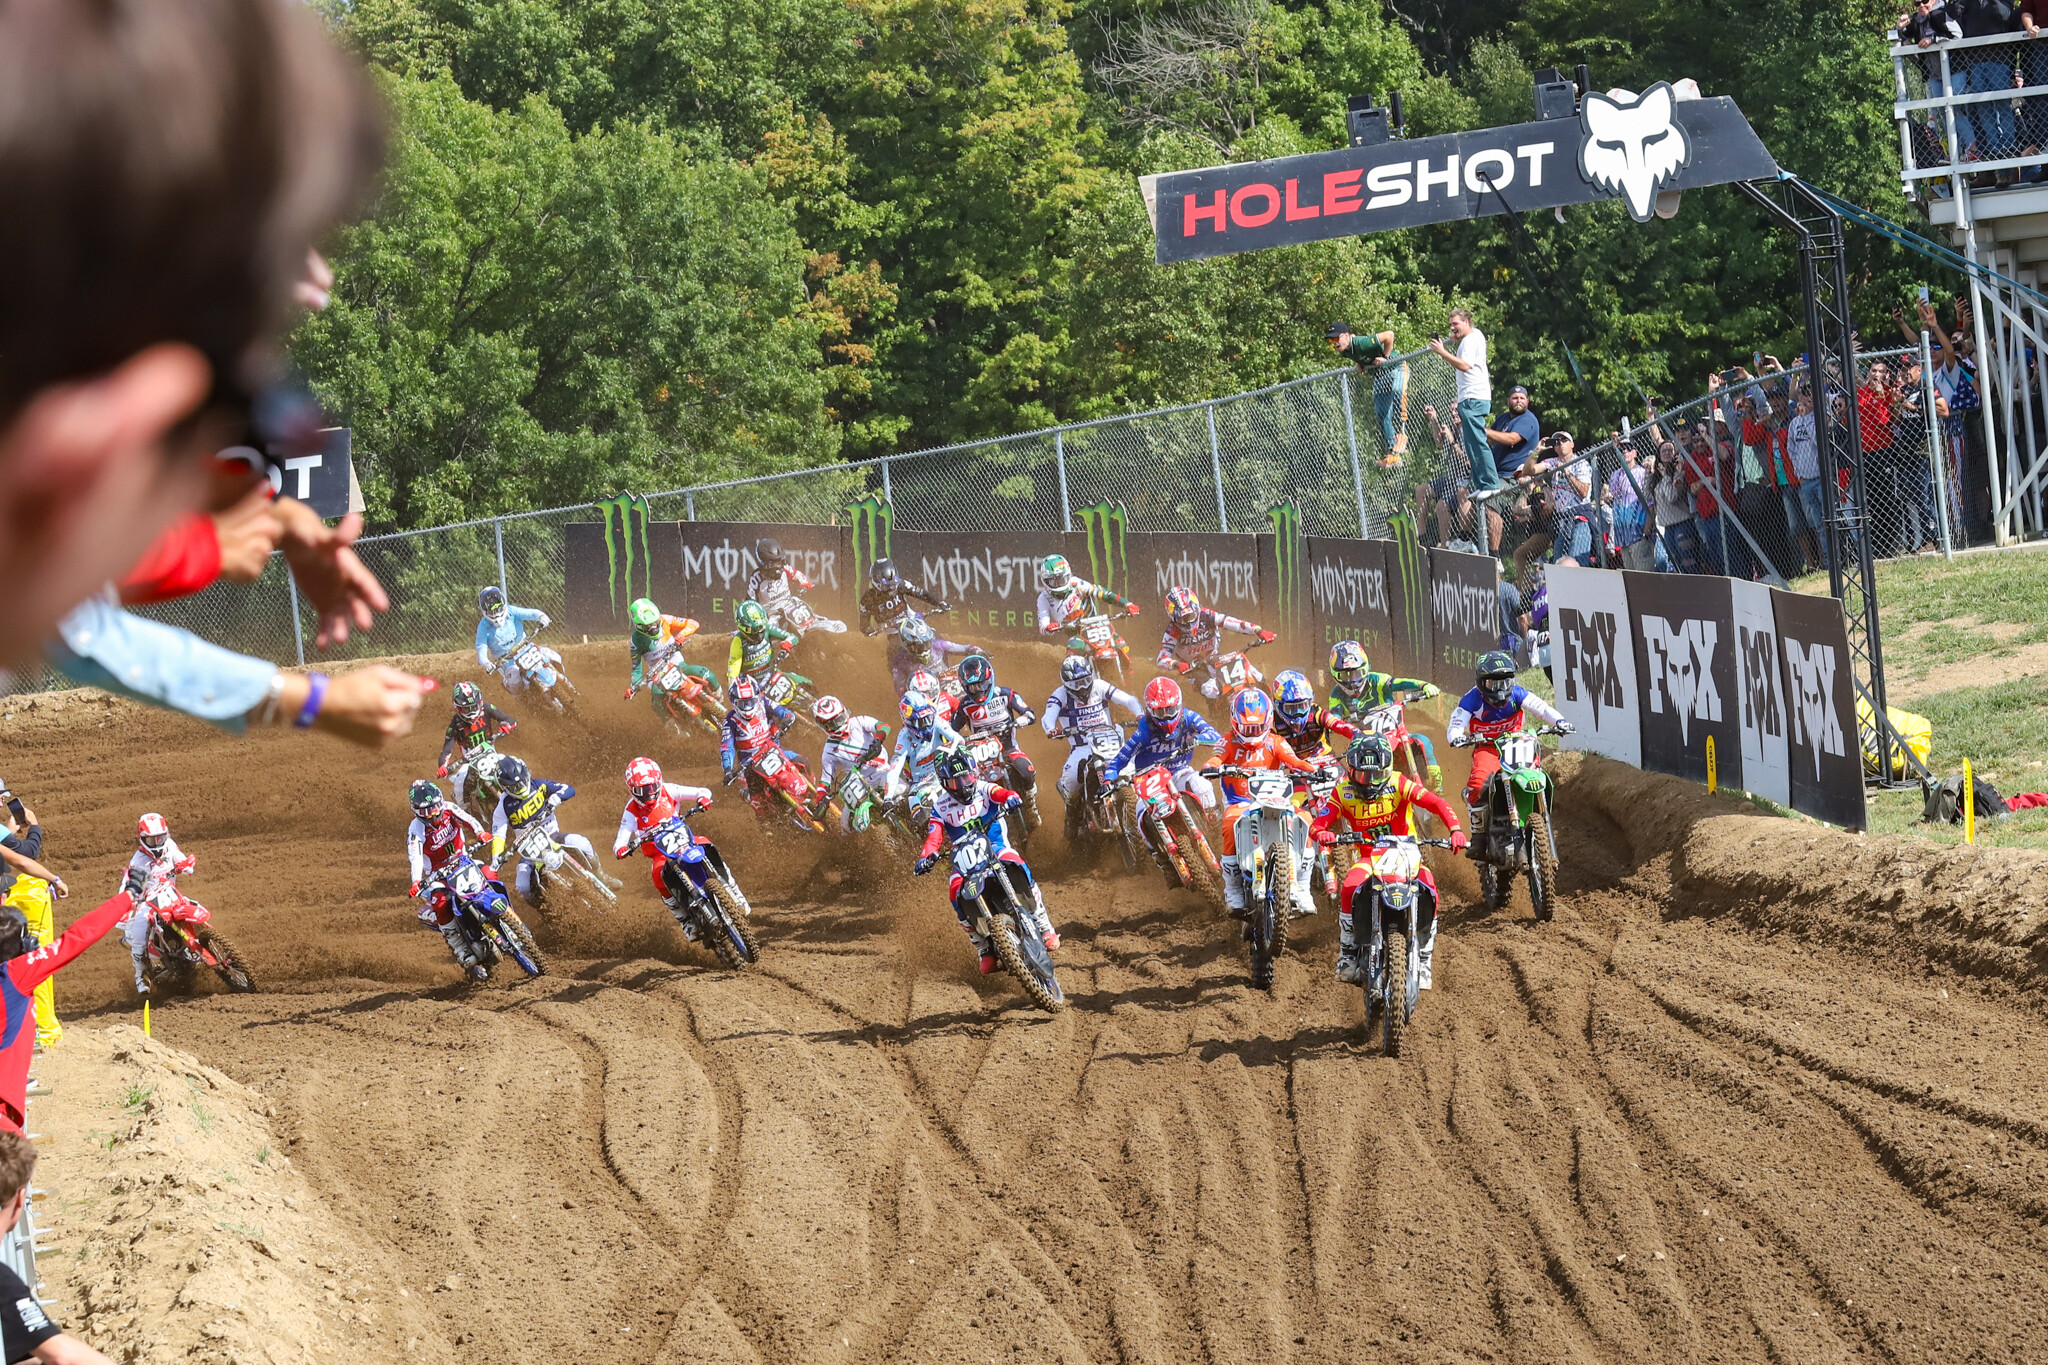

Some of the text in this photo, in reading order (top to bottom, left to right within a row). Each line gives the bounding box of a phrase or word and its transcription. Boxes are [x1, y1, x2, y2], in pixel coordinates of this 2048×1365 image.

[1183, 141, 1555, 237] HOLESHOT
[683, 538, 838, 592] MONTER
[922, 547, 1044, 601] MONSTE
[1311, 554, 1388, 617] MONSTER
[949, 610, 1034, 627] ENERG
[1431, 570, 1497, 640] MONSTER
[1220, 656, 1246, 684] 14
[1146, 773, 1161, 796] 2
[953, 837, 988, 874] 102
